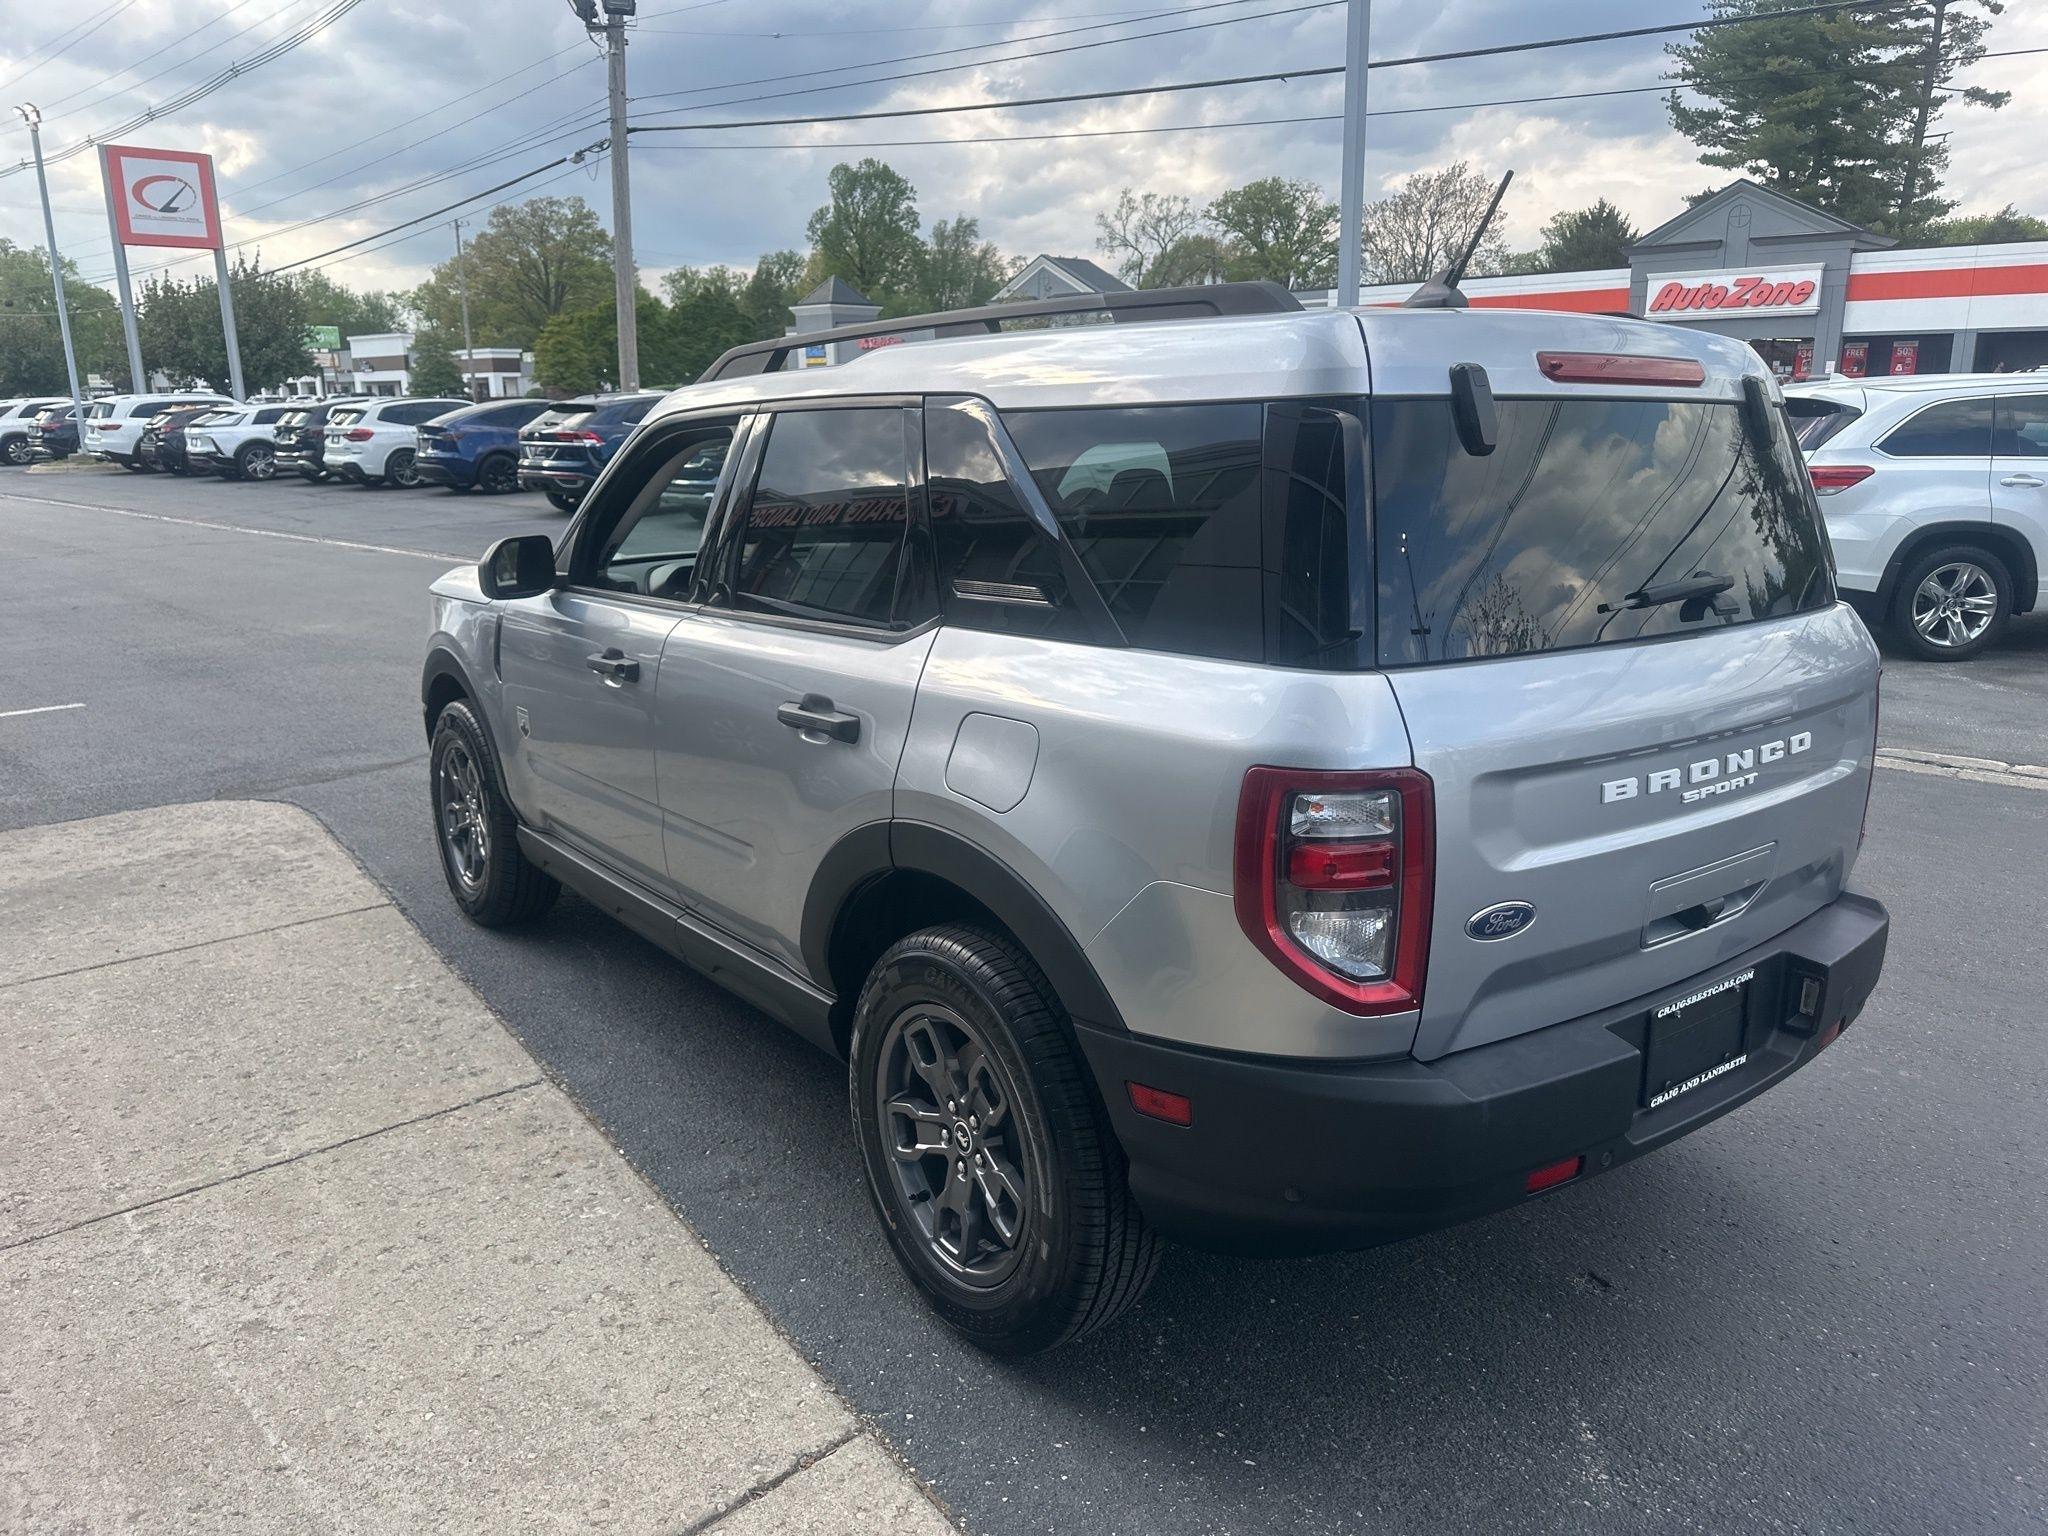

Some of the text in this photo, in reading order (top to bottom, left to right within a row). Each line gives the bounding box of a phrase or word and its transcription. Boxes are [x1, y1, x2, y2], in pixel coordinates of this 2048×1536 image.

[1650, 277, 1816, 312] AutoZone
[1846, 348, 1865, 357] FREE
[1601, 731, 1811, 803] BRONCO
[1681, 772, 1758, 803] SPORT
[1484, 910, 1524, 934] Ford
[1657, 970, 1755, 1018] CRAIGSBESTCARS.COM
[1650, 1054, 1748, 1108] CRAIG AND LANDRETH
